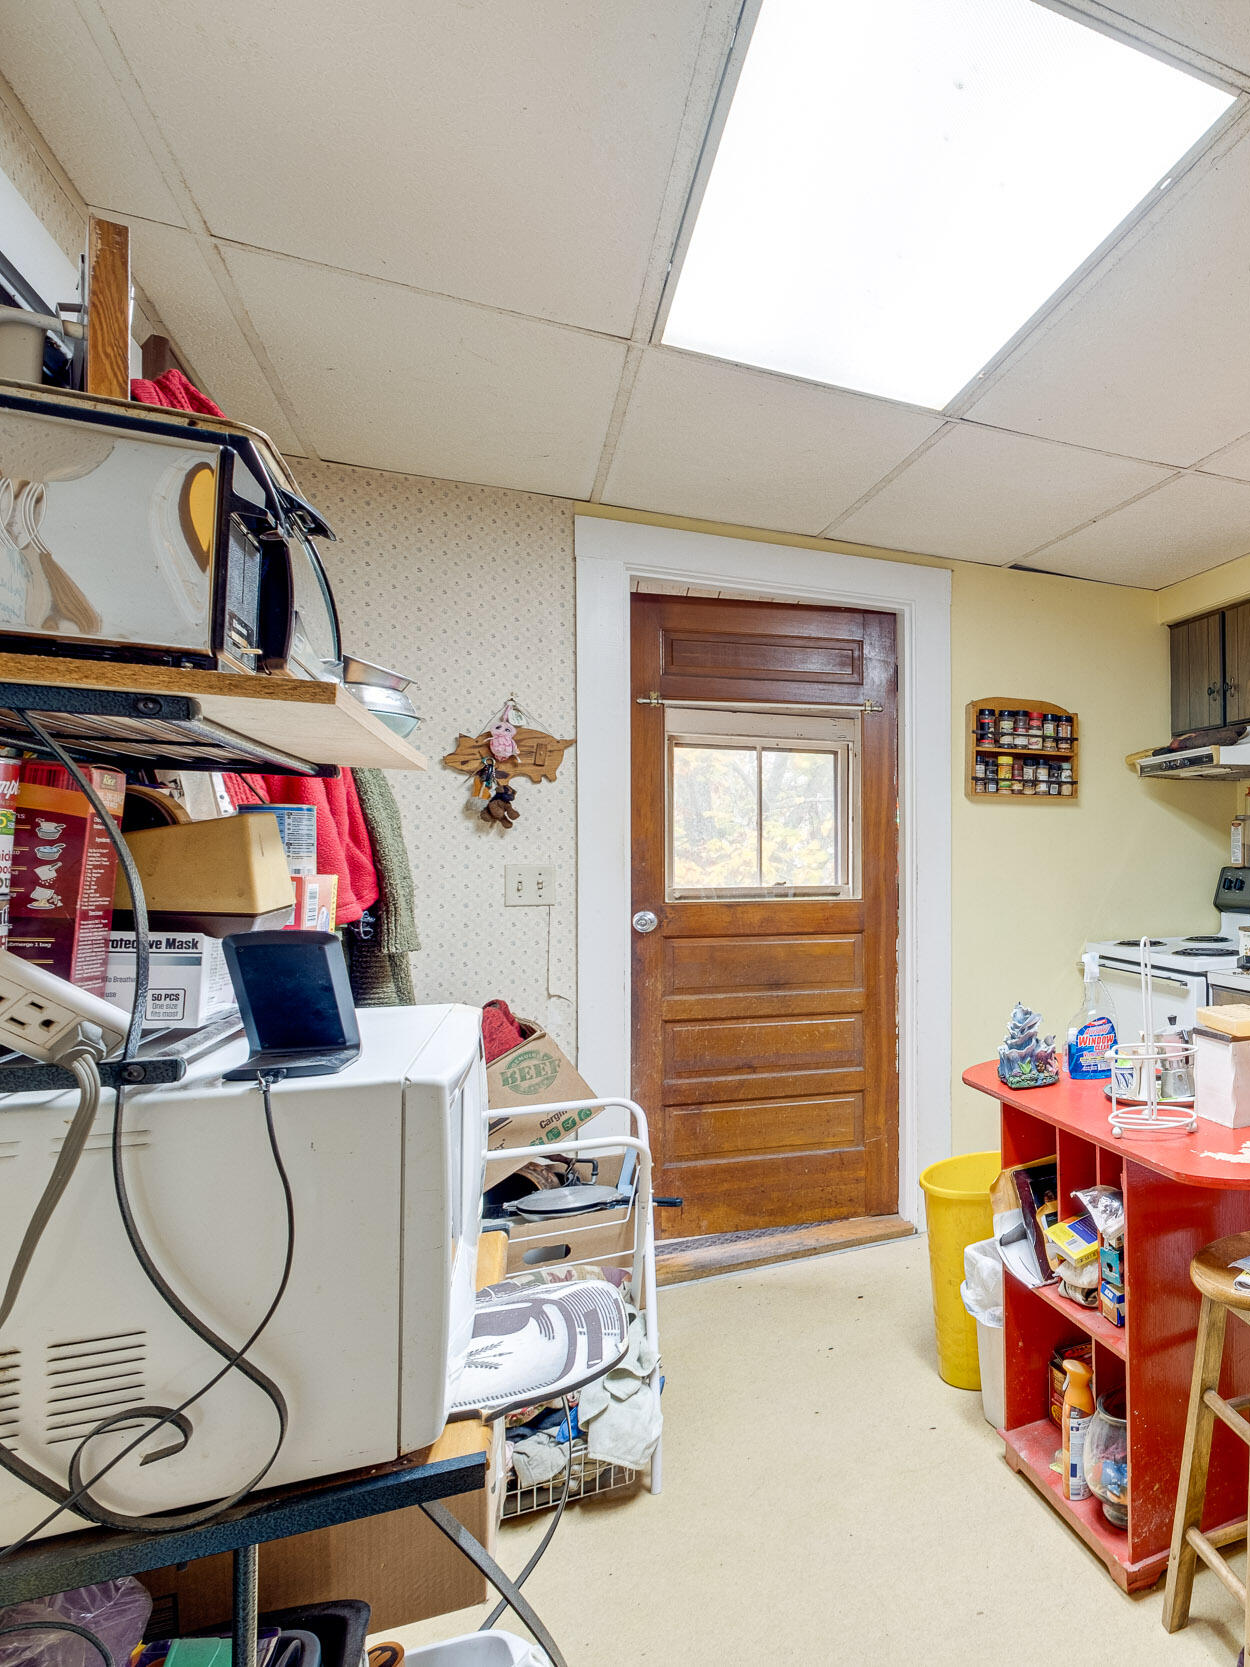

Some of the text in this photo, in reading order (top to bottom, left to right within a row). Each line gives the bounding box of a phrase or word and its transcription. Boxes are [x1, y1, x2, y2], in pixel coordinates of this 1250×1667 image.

[165, 938, 199, 950] Mask
[152, 993, 180, 1001] 50 PCS
[1078, 1034, 1114, 1047] WINDOW
[500, 1058, 561, 1087] BEEF
